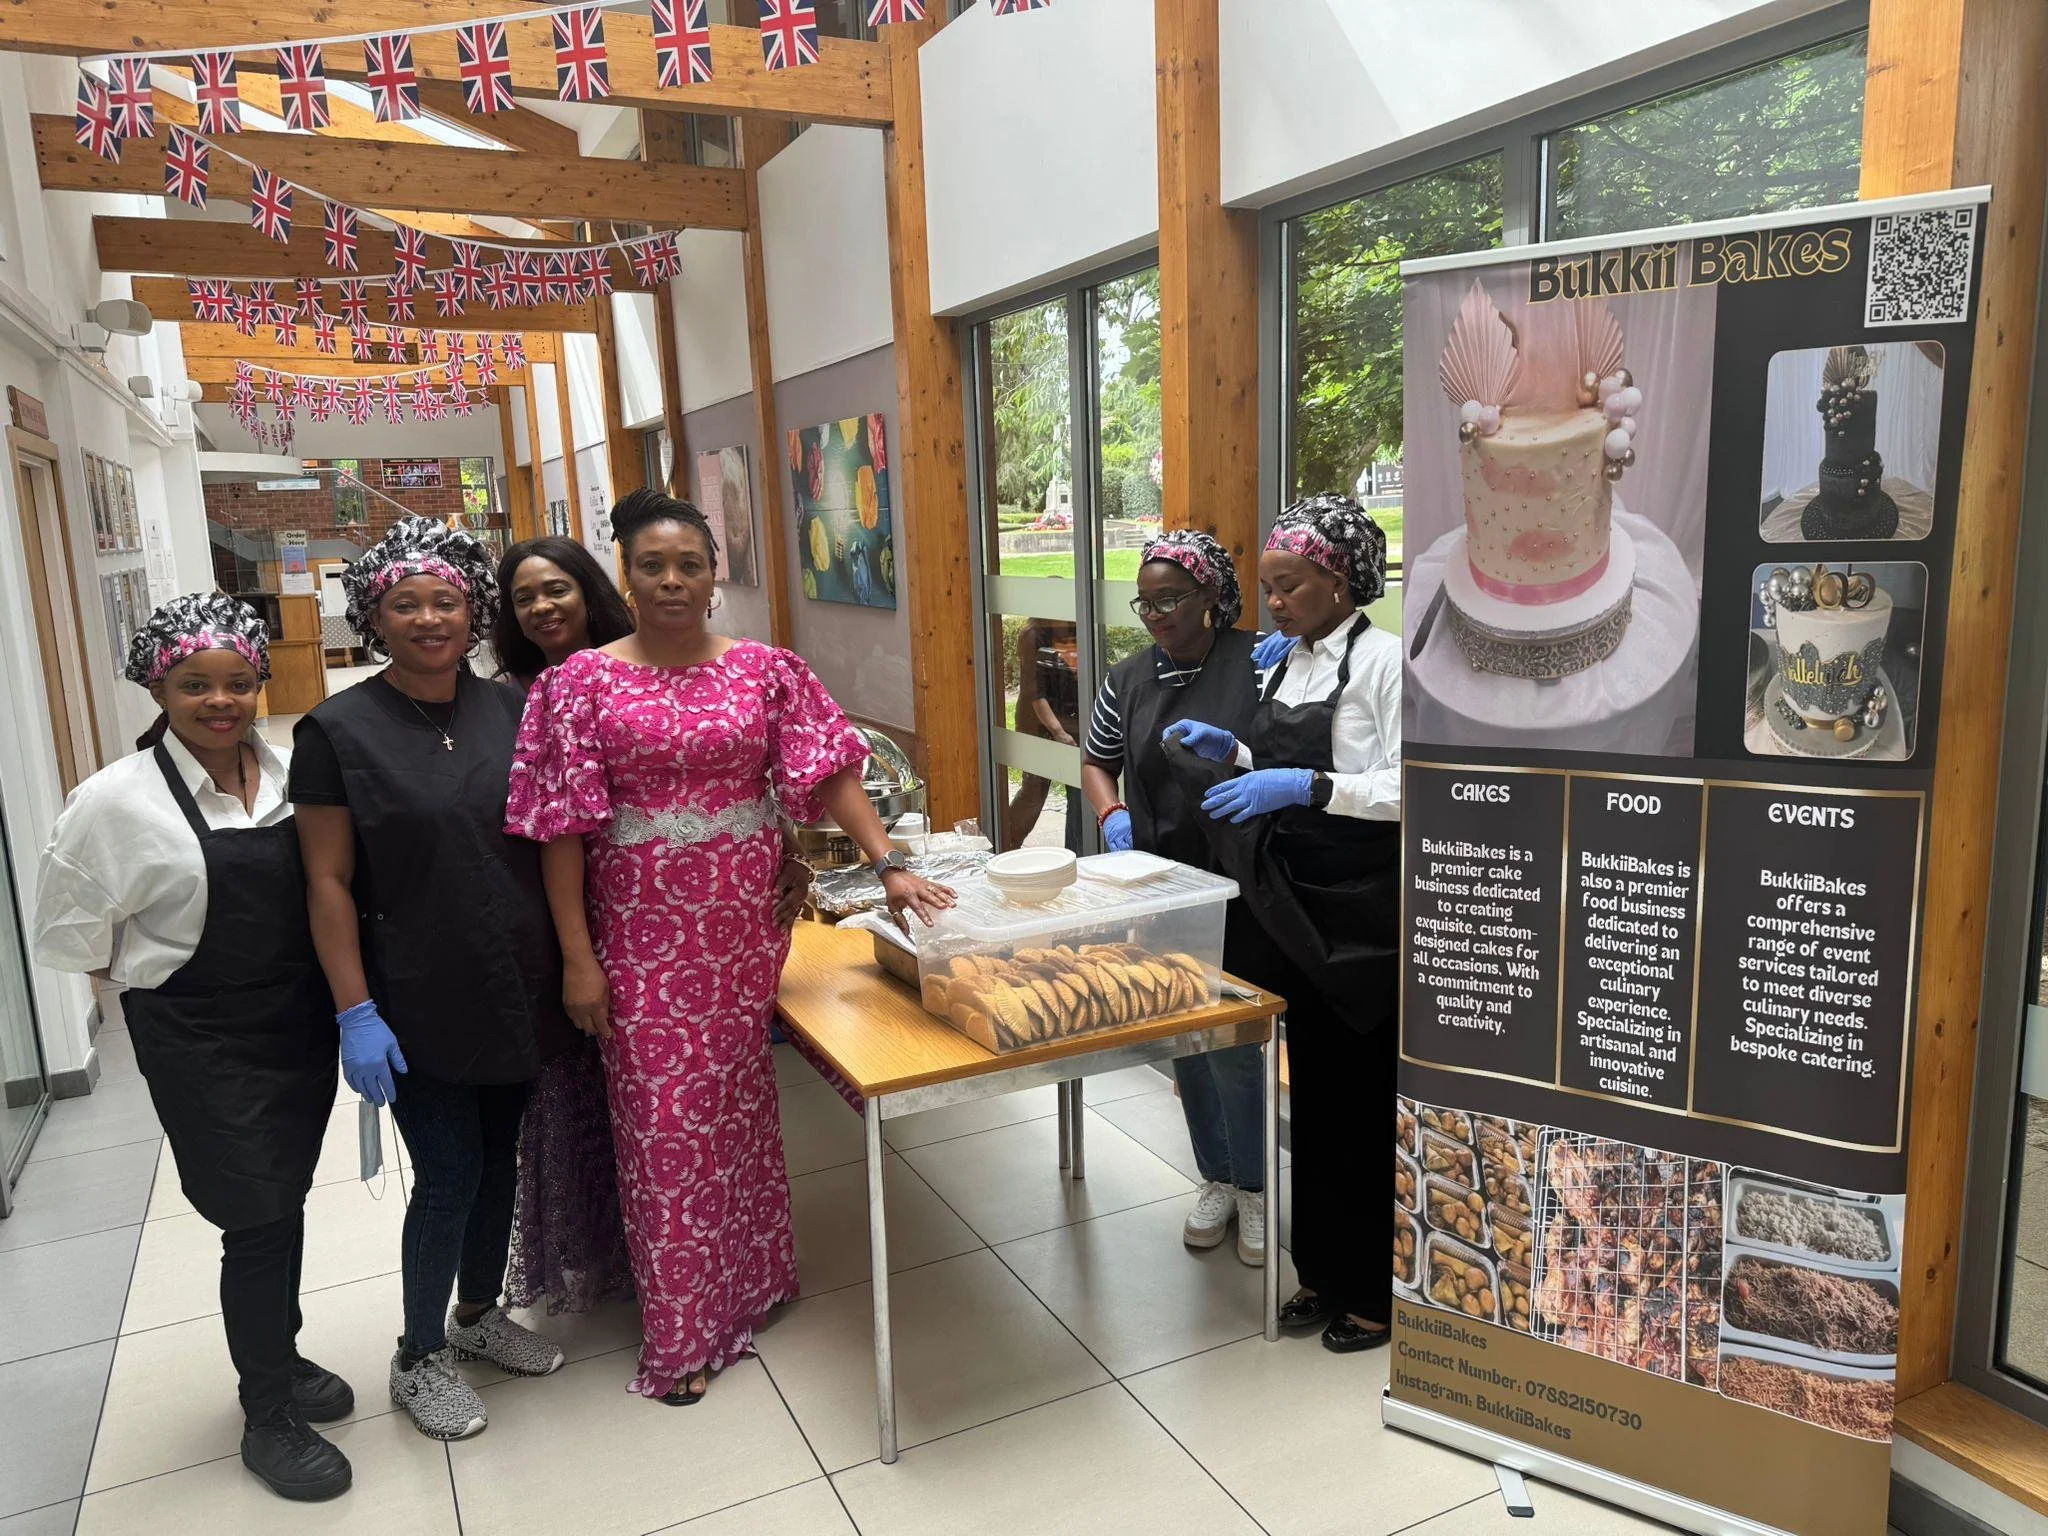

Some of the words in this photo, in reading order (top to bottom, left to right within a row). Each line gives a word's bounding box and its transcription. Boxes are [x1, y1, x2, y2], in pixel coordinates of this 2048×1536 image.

[1527, 241, 1679, 305] Bukkii
[1687, 228, 1852, 287] Bakes
[1451, 782, 1511, 803] CAKES
[1606, 792, 1661, 815] FOOD
[1768, 803, 1855, 829] EVENTS
[1422, 838, 1505, 859] BukkiiBakes
[1509, 845, 1521, 861] is
[1525, 850, 1533, 862] a
[1431, 861, 1484, 877] premier
[1488, 865, 1522, 880] cake
[1581, 851, 1674, 876] BukkiiBakes
[1678, 861, 1691, 878] is
[1415, 875, 1469, 895] business
[1473, 883, 1541, 902] dedicated
[1581, 873, 1612, 889] also
[1615, 879, 1624, 891] a
[1628, 881, 1689, 898] premier
[1760, 870, 1867, 896] BukkiiBakes
[1437, 900, 1451, 912] to
[1455, 903, 1513, 922] creating
[1583, 892, 1617, 911] food
[1621, 897, 1685, 919] business
[1777, 894, 1831, 915] offers
[1835, 904, 1846, 916] a
[1480, 924, 1538, 940] custom-
[1588, 913, 1658, 937] dedicated
[1662, 924, 1678, 939] to
[1747, 915, 1875, 942] comprehensive
[1414, 932, 1469, 953] designed
[1473, 941, 1513, 957] cakes
[1516, 944, 1539, 960] for
[1585, 933, 1658, 961] delivering
[1661, 947, 1680, 960] an
[1748, 937, 1796, 957] range
[1799, 940, 1819, 957] of
[1823, 947, 1871, 964] event
[1413, 951, 1429, 966] all
[1506, 962, 1539, 980] With
[1589, 957, 1674, 980] exceptional
[1738, 957, 1805, 977] services
[1809, 964, 1879, 986] tailored
[1418, 972, 1425, 983] a
[1428, 976, 1514, 996] commitment
[1518, 984, 1532, 998] to
[1600, 977, 1660, 1002] culinary
[1742, 976, 1760, 991] to
[1764, 982, 1804, 999] meet
[1809, 985, 1872, 1008] diverse
[1436, 994, 1483, 1014] quality
[1486, 1000, 1512, 1014] and
[1588, 996, 1671, 1020] experience.
[1743, 998, 1810, 1025] culinary
[1814, 1012, 1868, 1030] needs.
[1577, 1011, 1664, 1043] Specializing
[1668, 1025, 1681, 1042] in
[1745, 1017, 1844, 1052] Specializing
[1848, 1033, 1863, 1051] in
[1580, 1034, 1645, 1056] artisanal
[1649, 1047, 1676, 1062] and
[1730, 1035, 1797, 1061] bespoke
[1801, 1052, 1876, 1078] catering.
[1590, 1052, 1664, 1080] innovative
[1600, 1076, 1652, 1098] cuisine.
[1398, 1310, 1488, 1350] BukkiiBakes
[1398, 1341, 1454, 1369] Contact
[1525, 1380, 1642, 1431] 07882150730
[1396, 1369, 1472, 1407] Instagram:
[1476, 1395, 1572, 1441] BukkiiBakes
